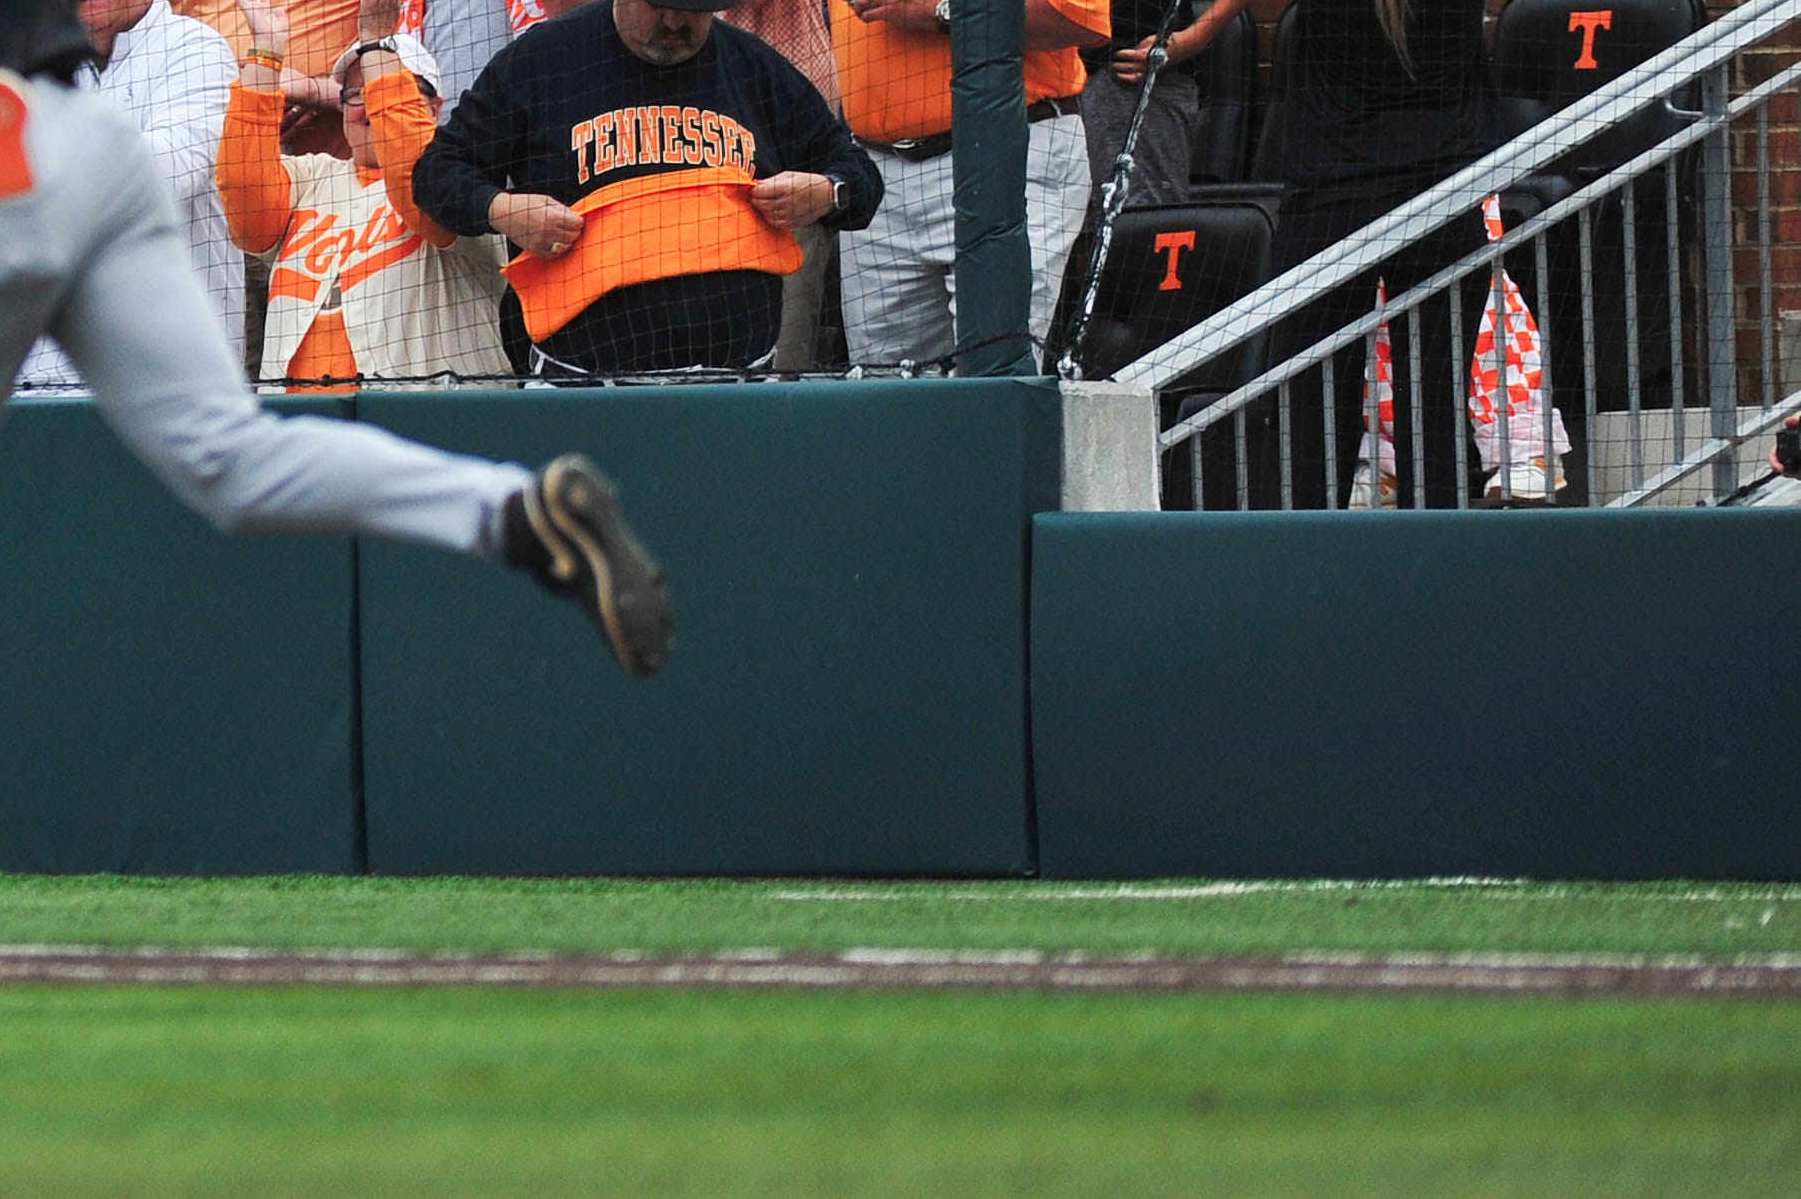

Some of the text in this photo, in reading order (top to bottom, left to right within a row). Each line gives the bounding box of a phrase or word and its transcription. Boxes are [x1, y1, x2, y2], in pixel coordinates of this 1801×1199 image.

[1568, 11, 1612, 69] T
[571, 105, 757, 186] TENNESSEE
[1154, 231, 1196, 290] T
